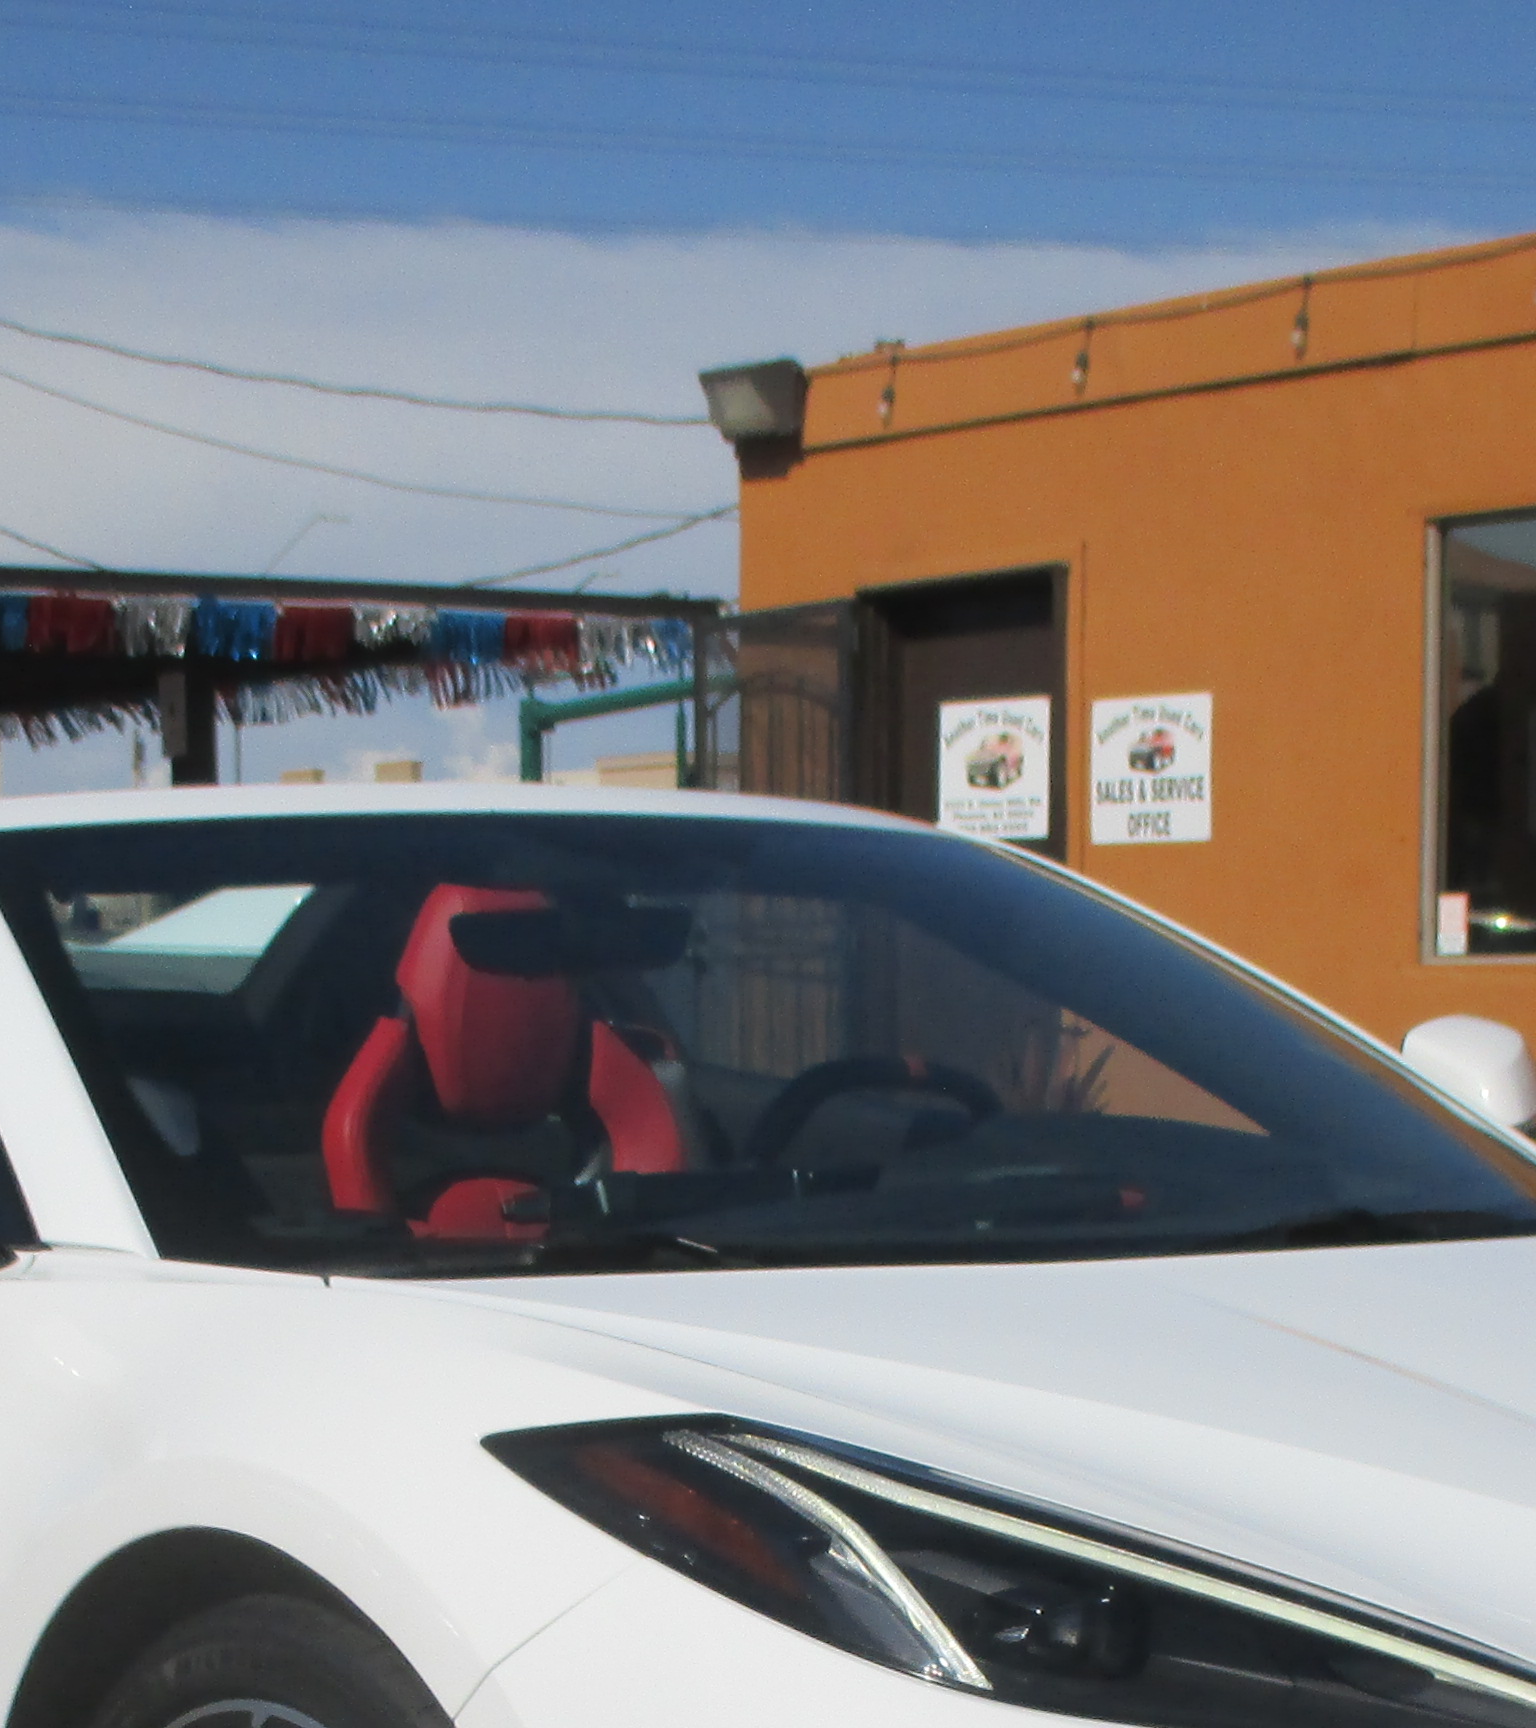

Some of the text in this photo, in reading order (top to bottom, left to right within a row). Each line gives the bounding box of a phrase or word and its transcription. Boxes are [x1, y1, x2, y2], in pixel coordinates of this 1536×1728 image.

[1097, 779, 1133, 804] SALES
[1151, 775, 1204, 801] SERVICE
[1128, 811, 1171, 836] OFFICE
